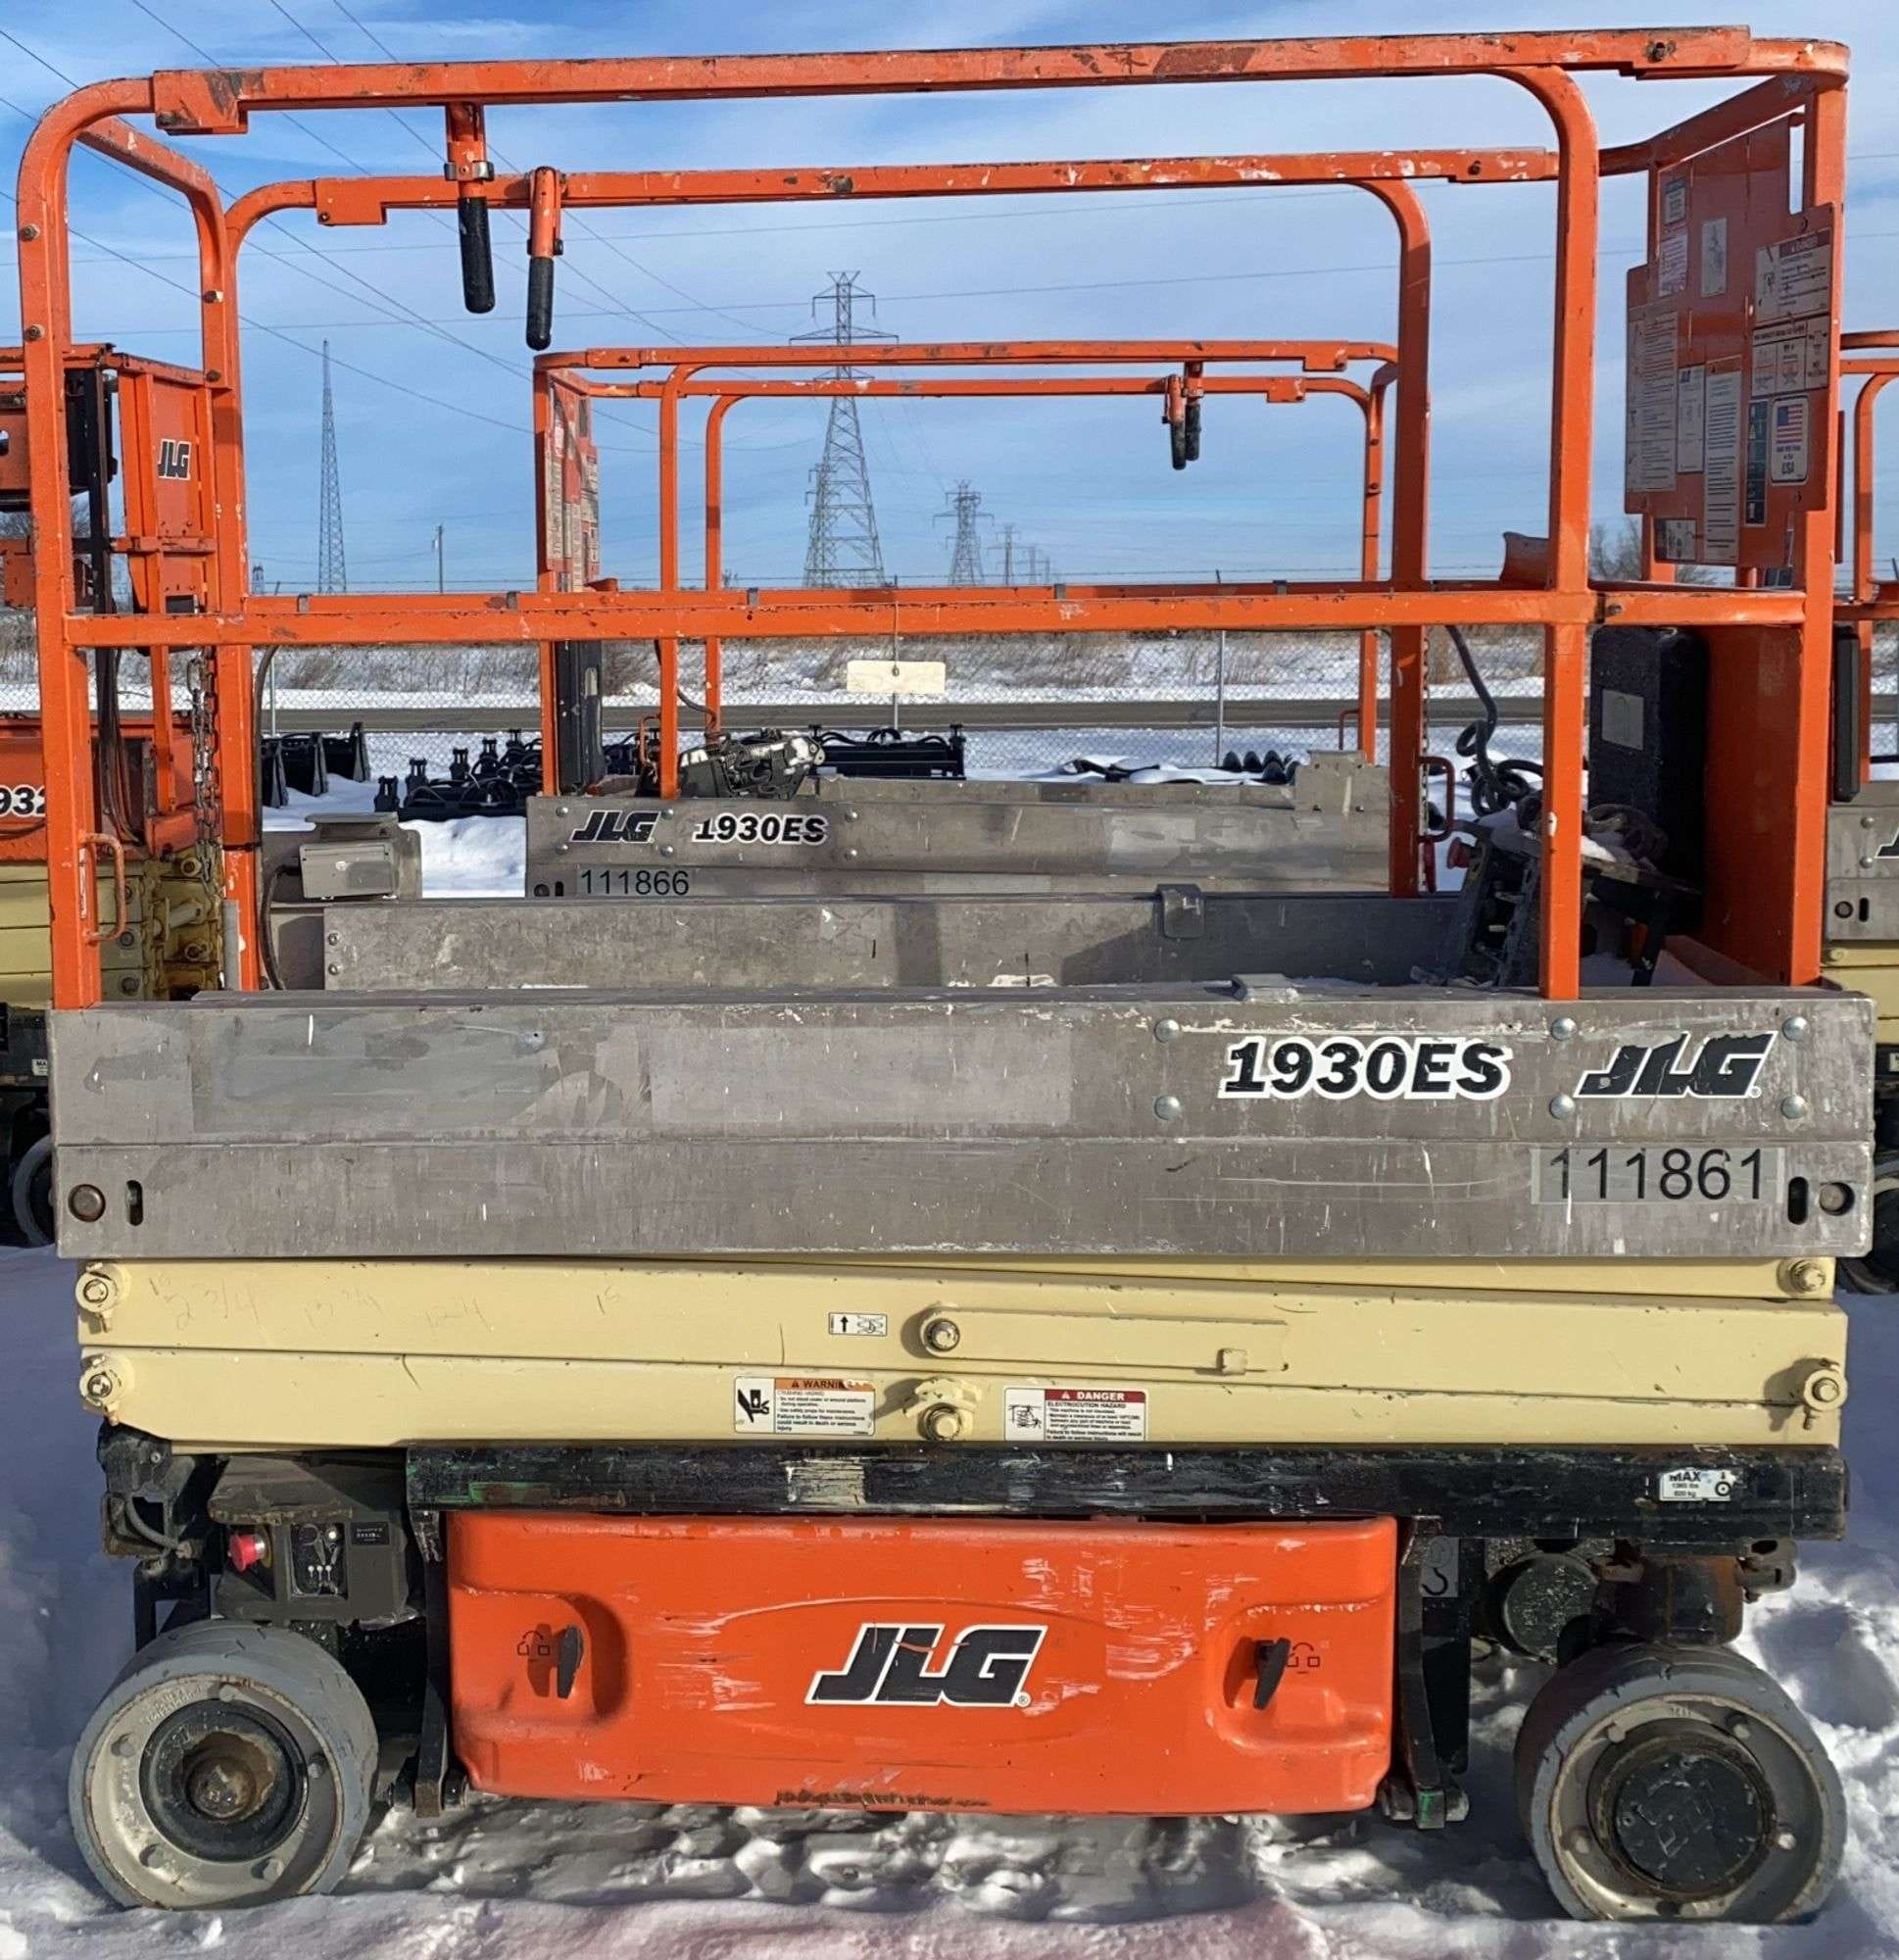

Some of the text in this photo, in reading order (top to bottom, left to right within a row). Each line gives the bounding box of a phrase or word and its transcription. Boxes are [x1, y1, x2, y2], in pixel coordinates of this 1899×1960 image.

[157, 438, 192, 480] JLG
[569, 810, 662, 844] JLG
[693, 812, 830, 845] 1930ES
[581, 870, 690, 896] 111866
[1219, 1036, 1514, 1101] 1930ES
[1575, 1031, 1777, 1099] JLG
[1550, 1147, 1763, 1200] 111861
[803, 1379, 853, 1389] WARNIN
[1077, 1392, 1125, 1401] DANGER
[1669, 1471, 1701, 1482] MAX
[804, 1623, 1048, 1707] JLG
